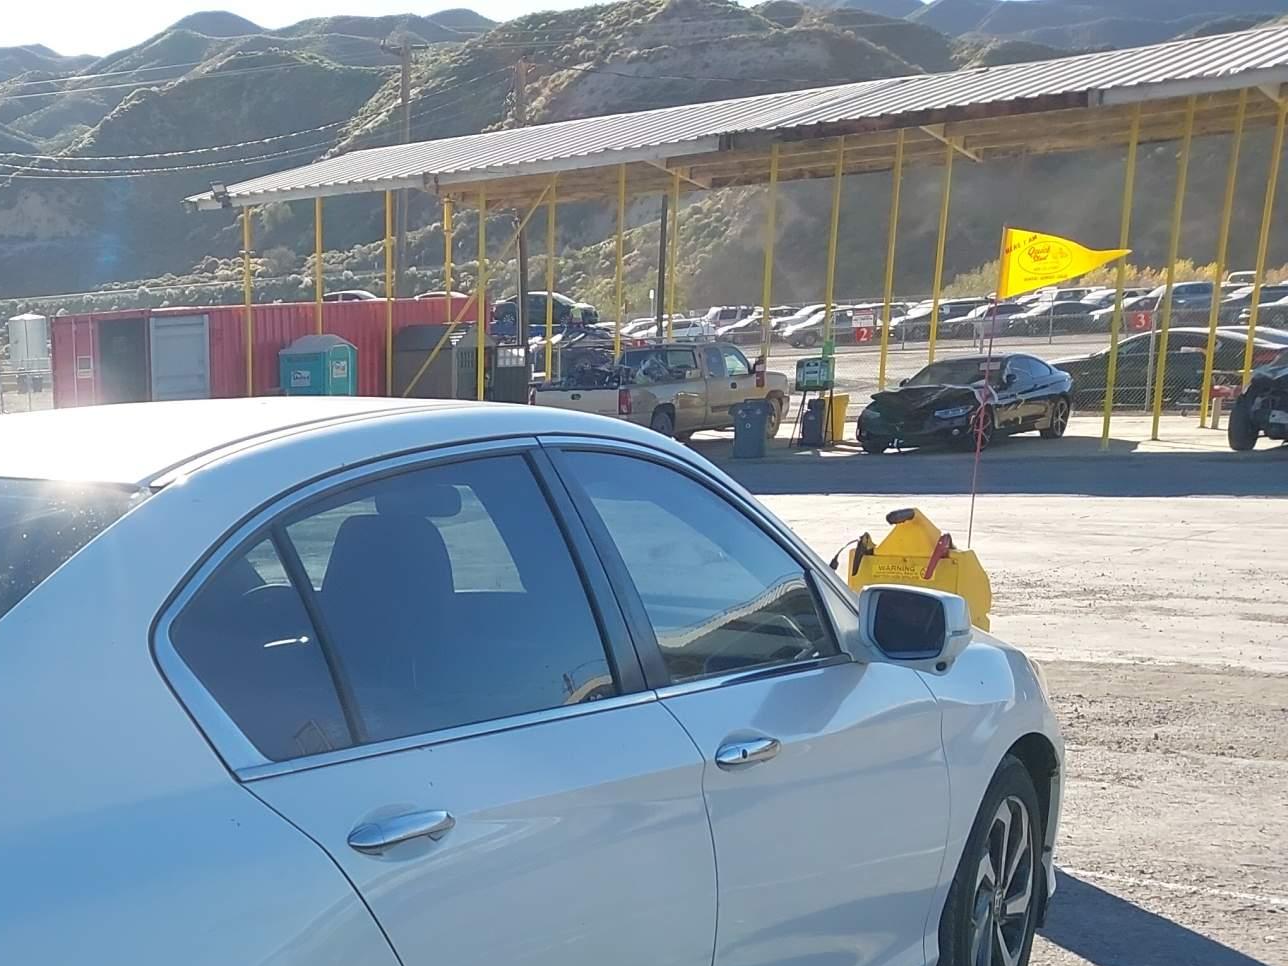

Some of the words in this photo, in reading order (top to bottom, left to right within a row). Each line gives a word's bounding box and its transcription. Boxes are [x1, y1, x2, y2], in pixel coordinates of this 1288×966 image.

[1135, 313, 1145, 328] 3
[859, 328, 868, 341] 2
[878, 564, 916, 572] WARNING
